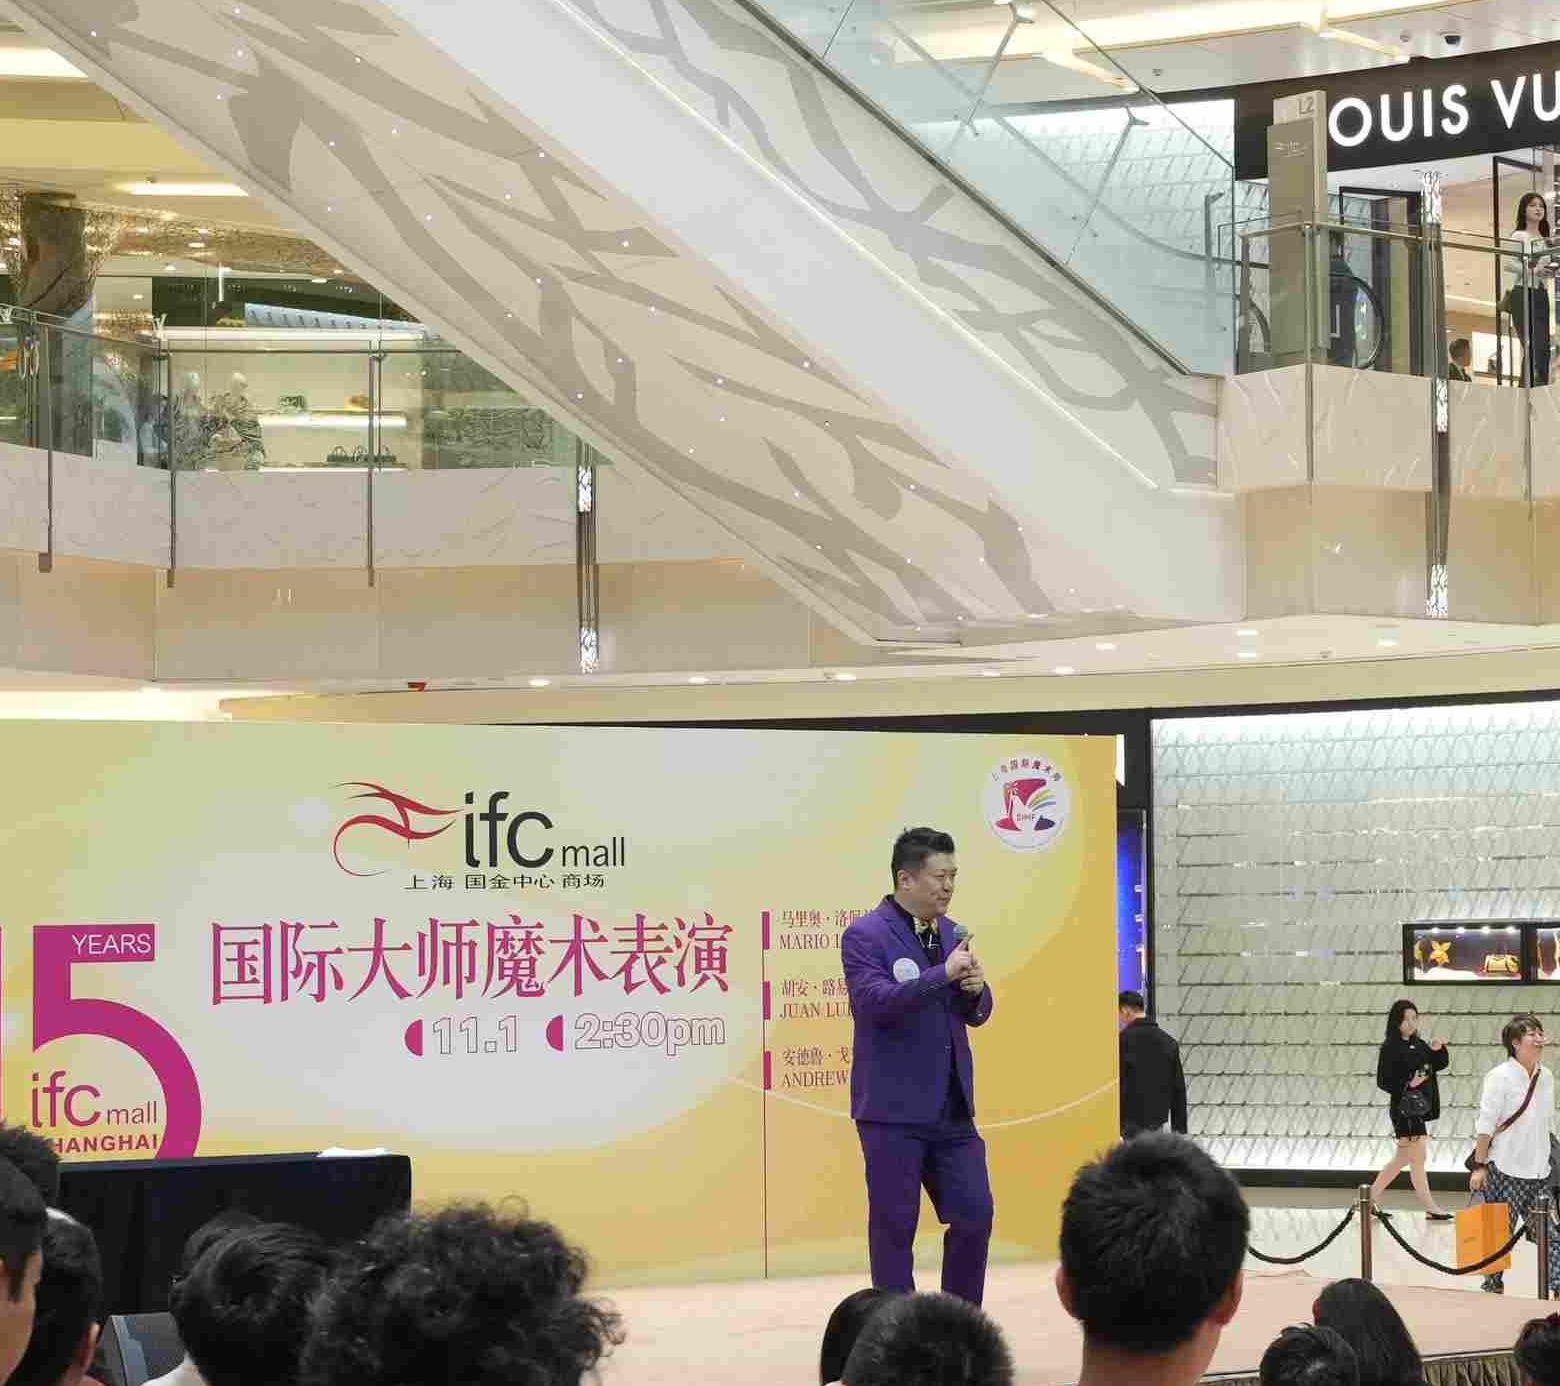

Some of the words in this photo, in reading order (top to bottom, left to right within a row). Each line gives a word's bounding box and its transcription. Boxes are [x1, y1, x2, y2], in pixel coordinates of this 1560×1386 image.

[1328, 85, 1468, 147] OUIS
[464, 790, 555, 869] ifc
[561, 836, 626, 867] mall
[404, 873, 454, 890] 上海
[464, 873, 555, 890] 国金中心
[561, 873, 606, 889] 商场
[71, 933, 152, 955] YEARS
[779, 935, 830, 950] MARIO
[211, 912, 735, 1005] 国际大师魔术表演
[779, 1002, 822, 1019] JUAN
[432, 1014, 519, 1055] 11.1
[574, 1011, 726, 1056] 2:30pm
[782, 1069, 848, 1088] ANDREW
[32, 1070, 101, 1128] ifc
[106, 1100, 158, 1125] mall
[51, 1134, 158, 1153] HANGHAI
